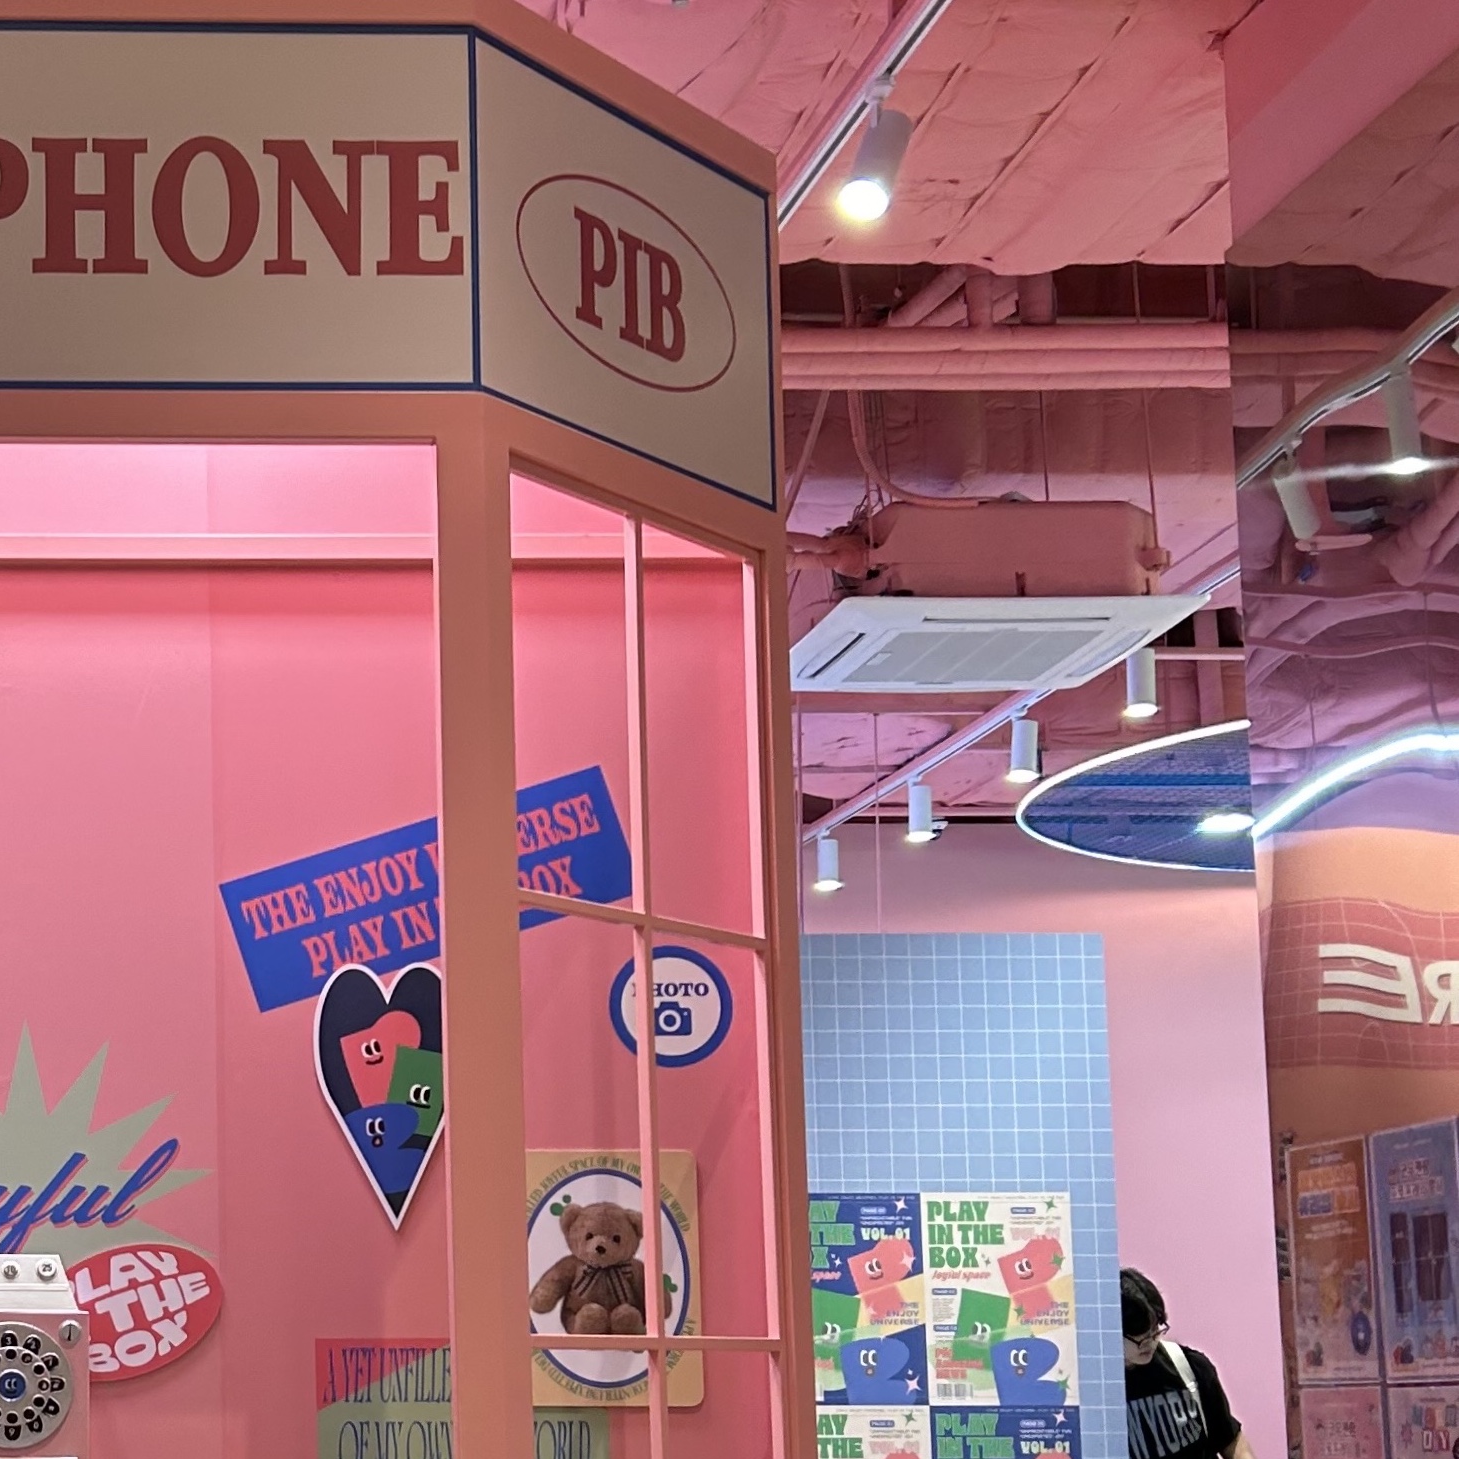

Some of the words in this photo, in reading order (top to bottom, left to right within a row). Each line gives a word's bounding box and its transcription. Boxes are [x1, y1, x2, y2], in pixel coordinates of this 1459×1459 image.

[574, 205, 686, 363] PIB
[241, 883, 316, 940] THE
[313, 848, 424, 918] ENJOY
[301, 915, 391, 978] PLAY
[390, 901, 437, 949] IN
[631, 983, 709, 997] HOTO
[927, 1200, 989, 1222] PLAY
[928, 1224, 954, 1245] IN
[957, 1224, 1005, 1245] THE
[929, 1246, 979, 1268] BOX
[70, 1250, 179, 1304] LAY
[94, 1271, 210, 1333] THE
[870, 1318, 920, 1326] UNIVERSE
[1020, 1318, 1070, 1326] UNIVERSE
[89, 1310, 188, 1373] BOX
[323, 1347, 338, 1403] A
[341, 1347, 376, 1403] YET
[935, 1413, 999, 1436] PLAY
[936, 1436, 964, 1459] IN
[966, 1436, 1015, 1459] THE
